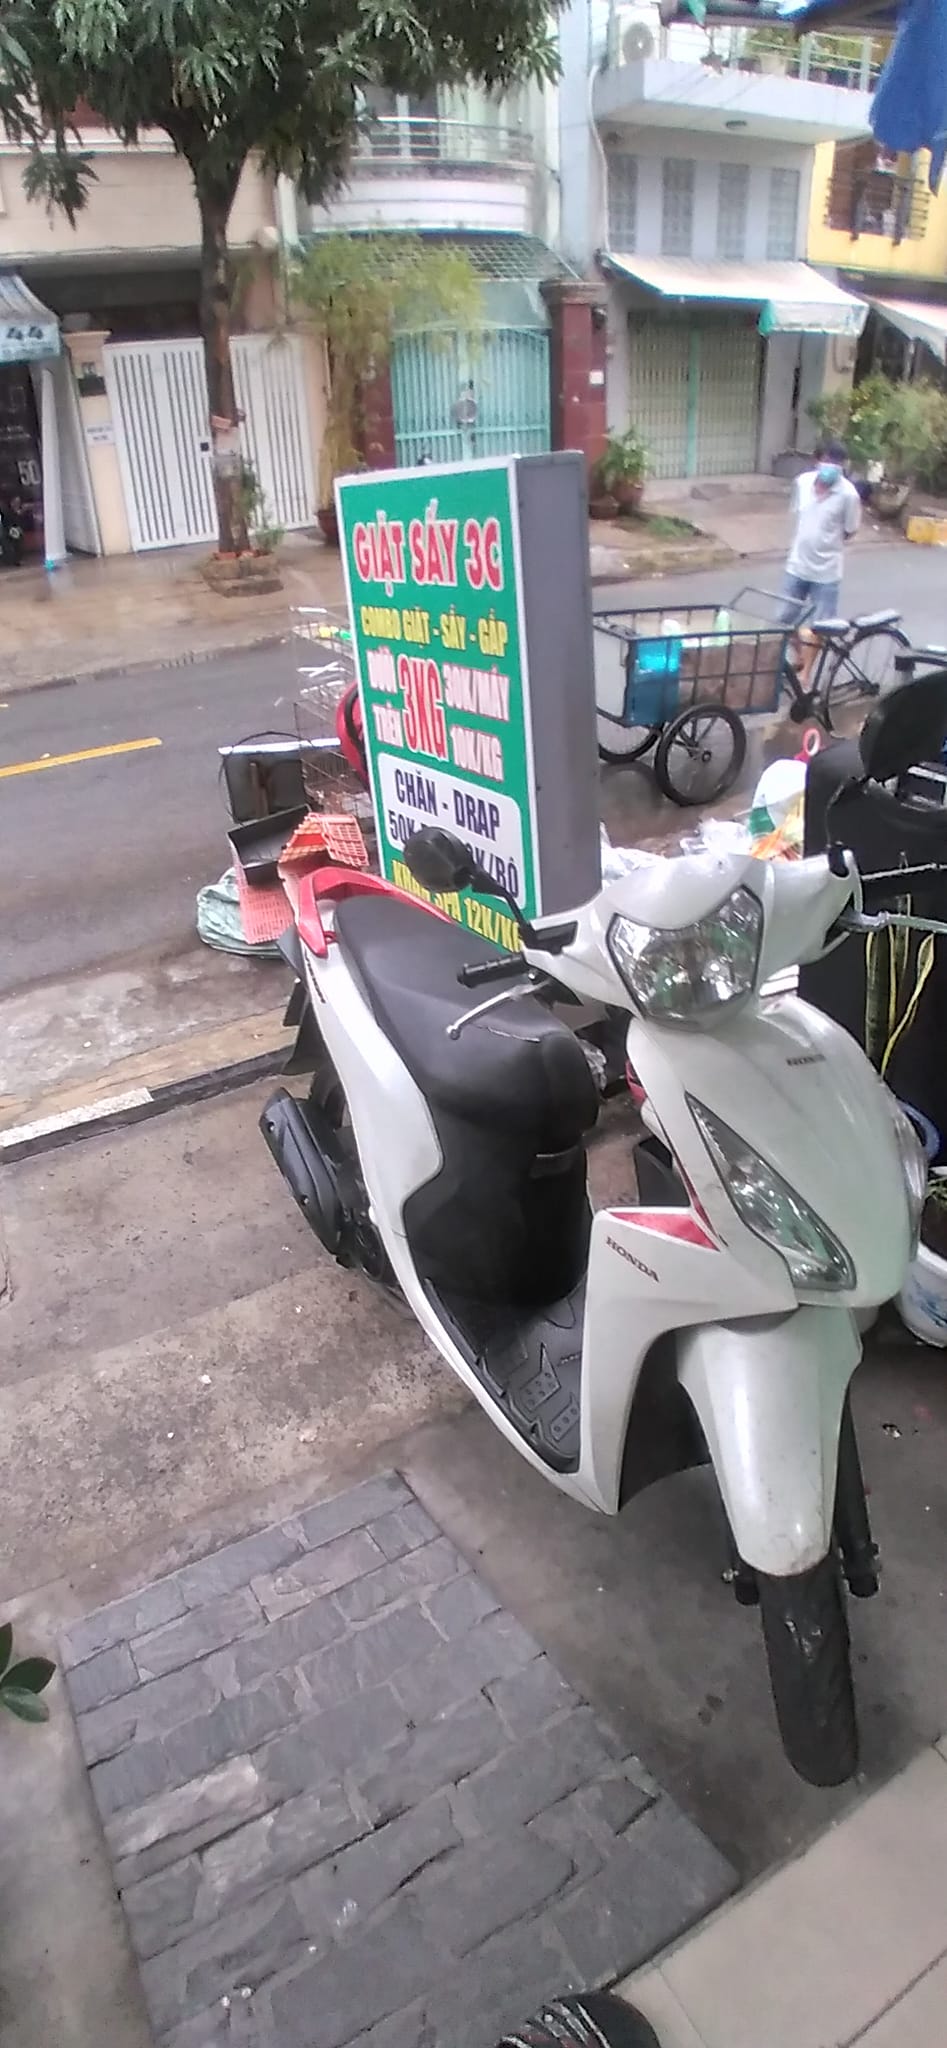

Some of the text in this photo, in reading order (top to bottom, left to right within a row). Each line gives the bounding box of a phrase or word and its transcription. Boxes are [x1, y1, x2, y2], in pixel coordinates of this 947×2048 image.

[353, 498, 504, 597] GIẶT SẤY 3C
[361, 606, 401, 640] COMBO
[402, 605, 430, 649] GIẶT
[440, 603, 466, 650] SẤY
[478, 607, 508, 657] GẤP
[397, 653, 449, 761] 3KG
[442, 662, 510, 722] 30K/MÁY
[450, 724, 504, 782] 10K/KG
[395, 768, 438, 817] CHĂN
[453, 788, 500, 841] DRAP
[606, 1236, 660, 1283] HONDA
